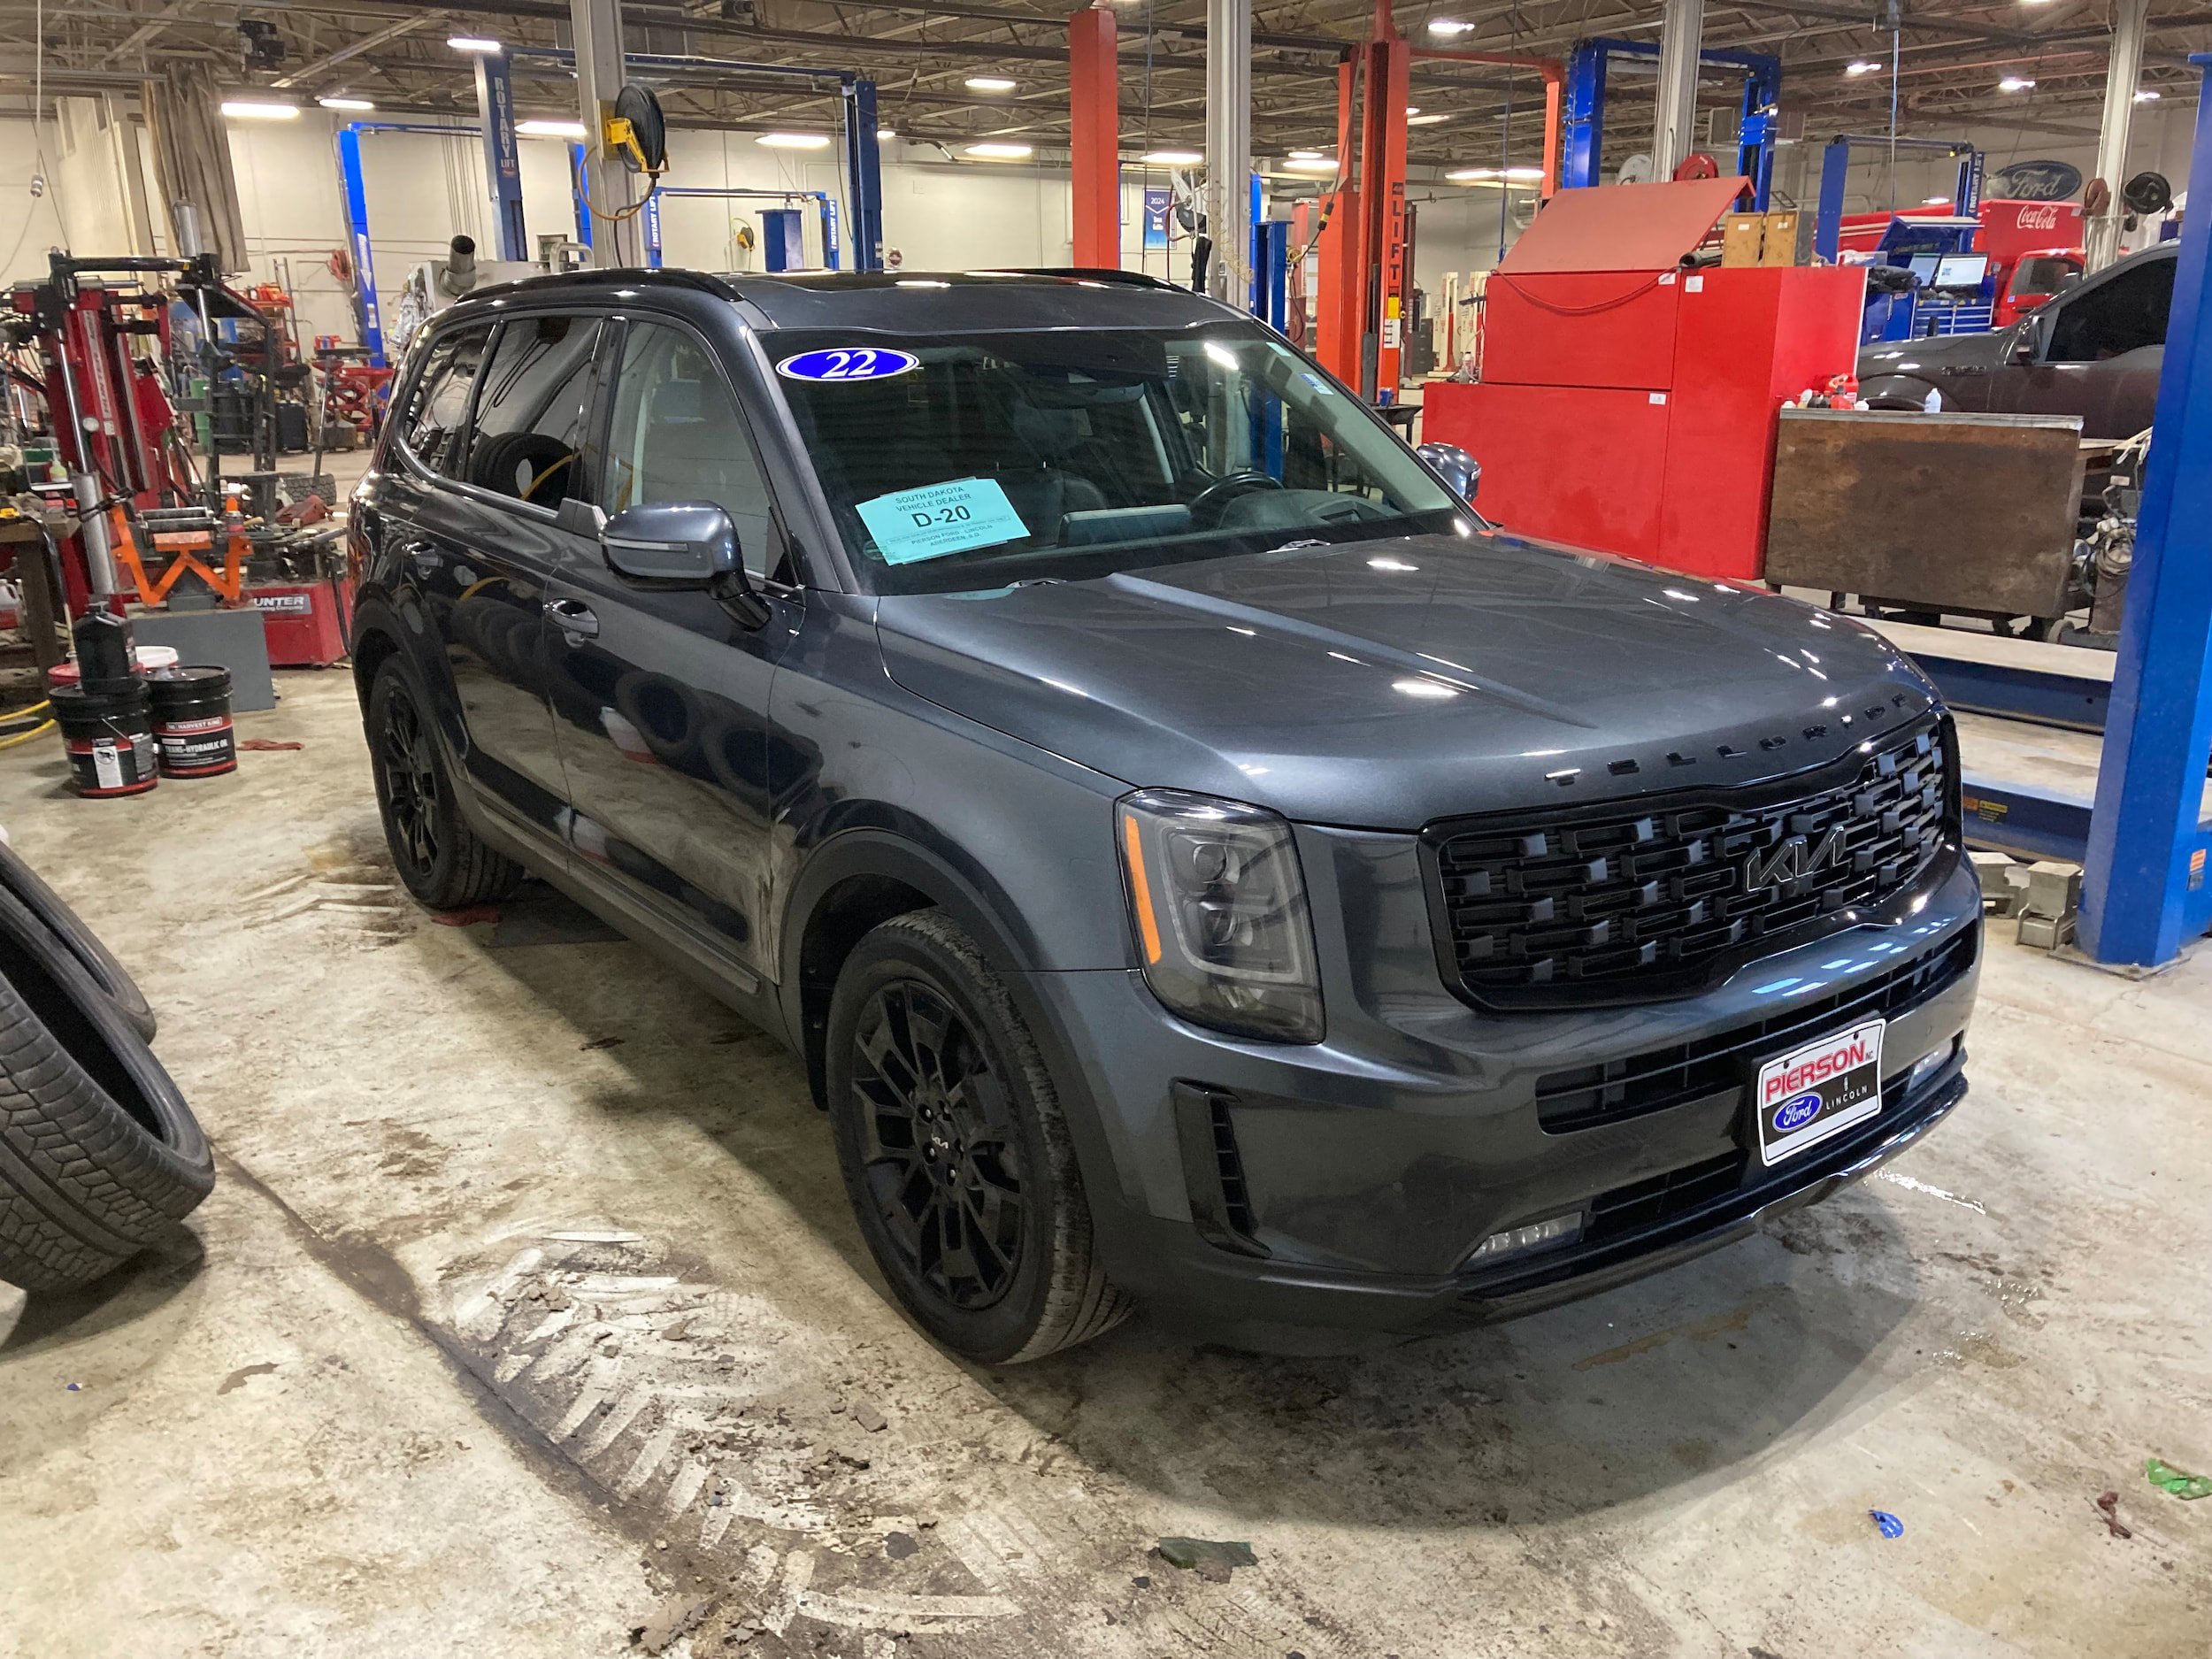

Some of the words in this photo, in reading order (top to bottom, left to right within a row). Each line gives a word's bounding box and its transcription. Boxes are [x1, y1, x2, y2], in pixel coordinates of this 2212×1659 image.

[494, 77, 511, 158] ROTARY
[500, 158, 515, 168] LIFT
[1969, 173, 1981, 209] ROTARY
[2005, 169, 2064, 199] Ford
[650, 212, 659, 242] ROTARY
[1390, 200, 1402, 280] LIFT
[821, 349, 877, 379] 22
[895, 495, 926, 505] SOUTH
[929, 486, 965, 499] DAKOTA
[895, 501, 934, 512] VEHICLE
[935, 493, 972, 506] DEALER
[911, 505, 971, 528] D-20
[911, 534, 941, 545] PIERSON
[941, 530, 960, 539] FORD
[965, 524, 994, 534] LINCOLN
[254, 596, 304, 607] UNTER
[177, 721, 207, 730] HARVEST
[1765, 1039, 1866, 1104] PIERSON
[1825, 1085, 1868, 1110] LINCOLN
[1783, 1100, 1813, 1126] Ford
